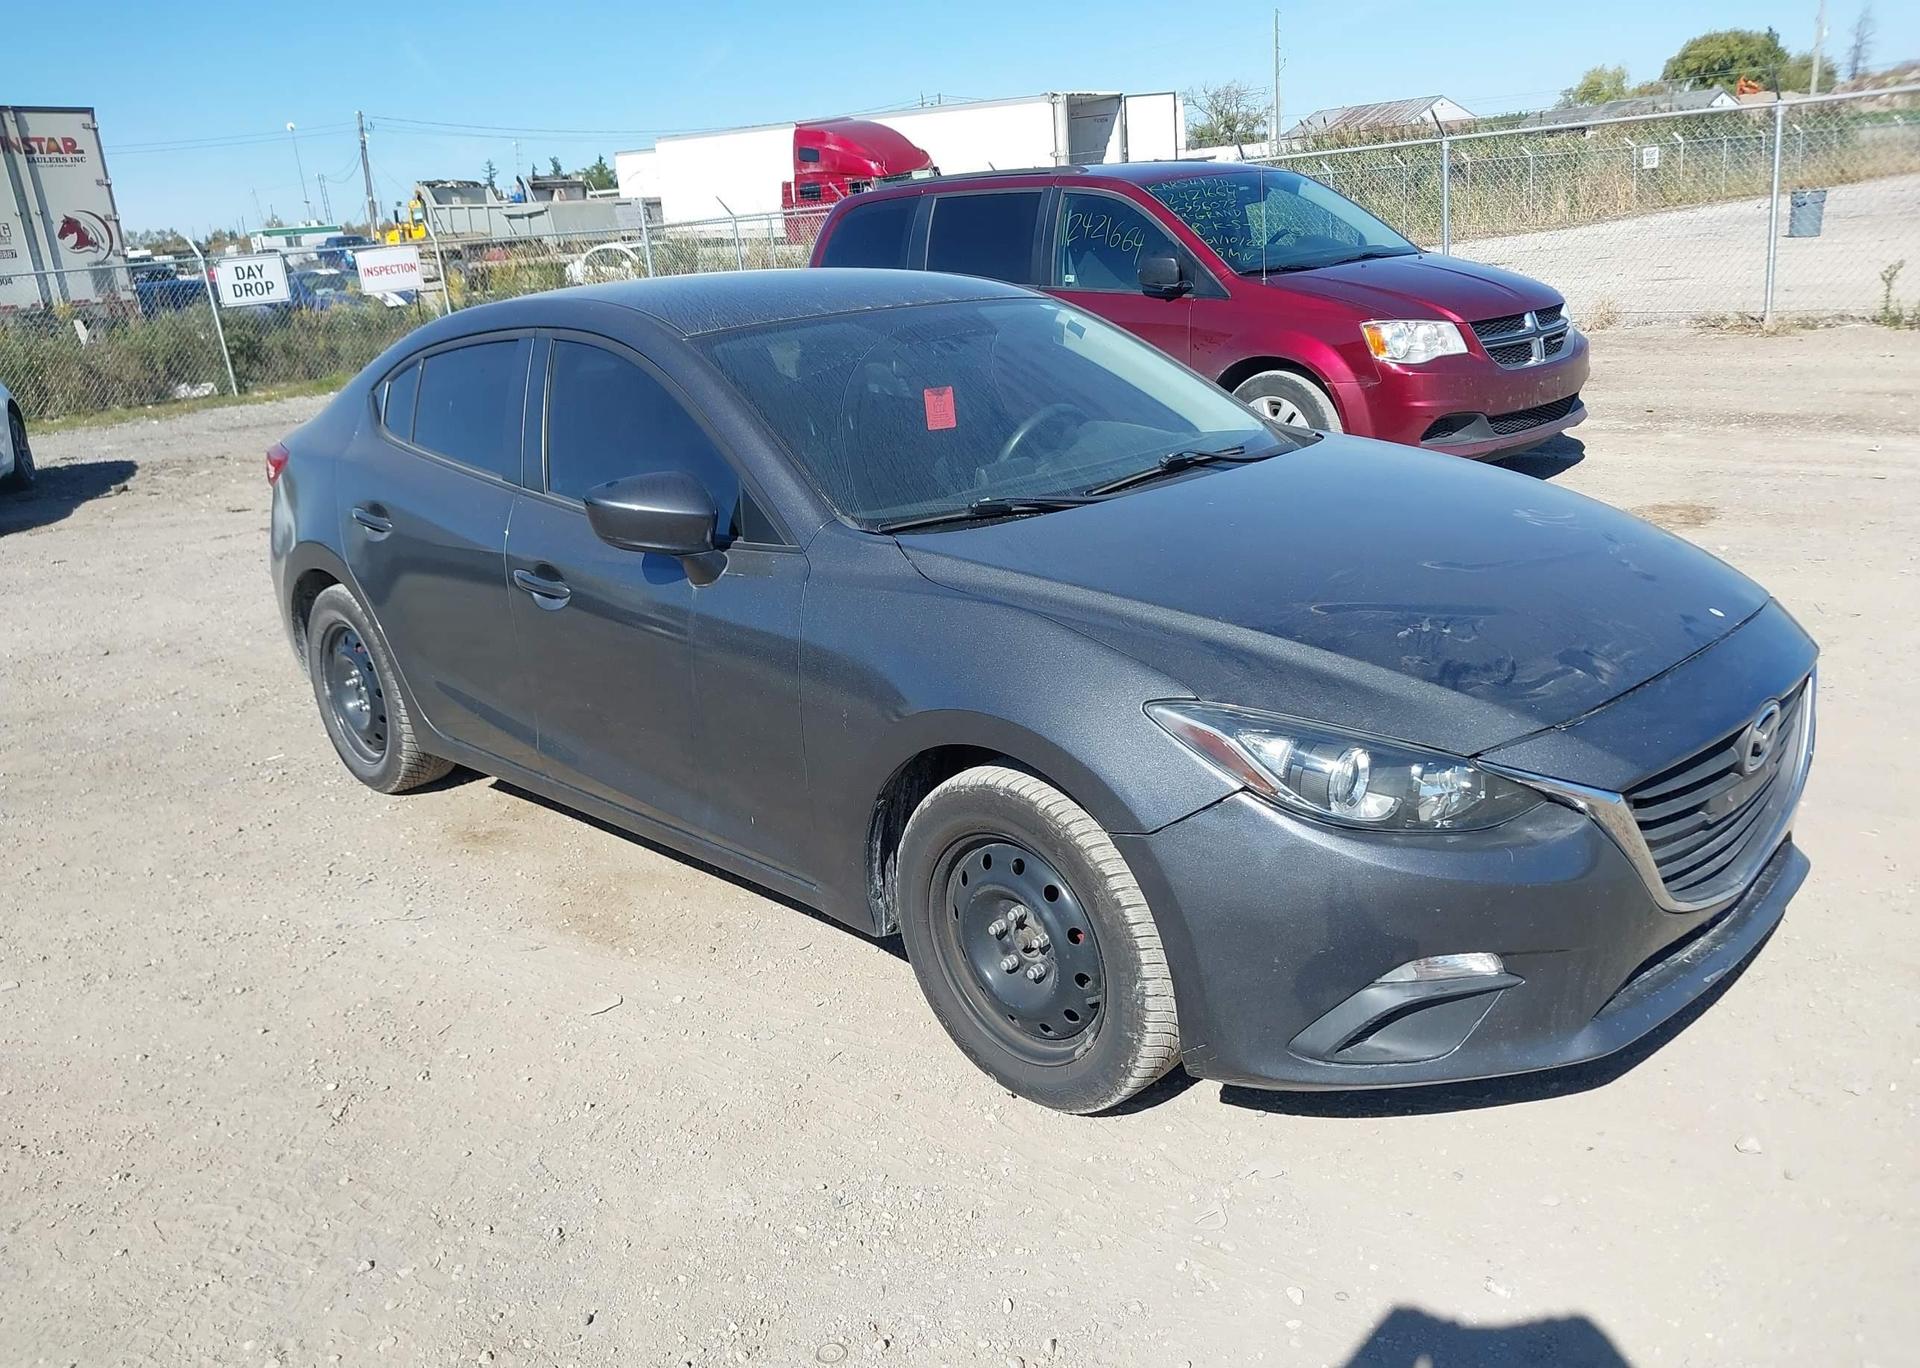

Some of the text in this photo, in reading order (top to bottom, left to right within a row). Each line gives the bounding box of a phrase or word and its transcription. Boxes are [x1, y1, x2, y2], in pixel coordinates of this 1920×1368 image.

[234, 263, 265, 281] DAY
[363, 262, 417, 278] INSPECTION
[232, 280, 275, 298] DROP
